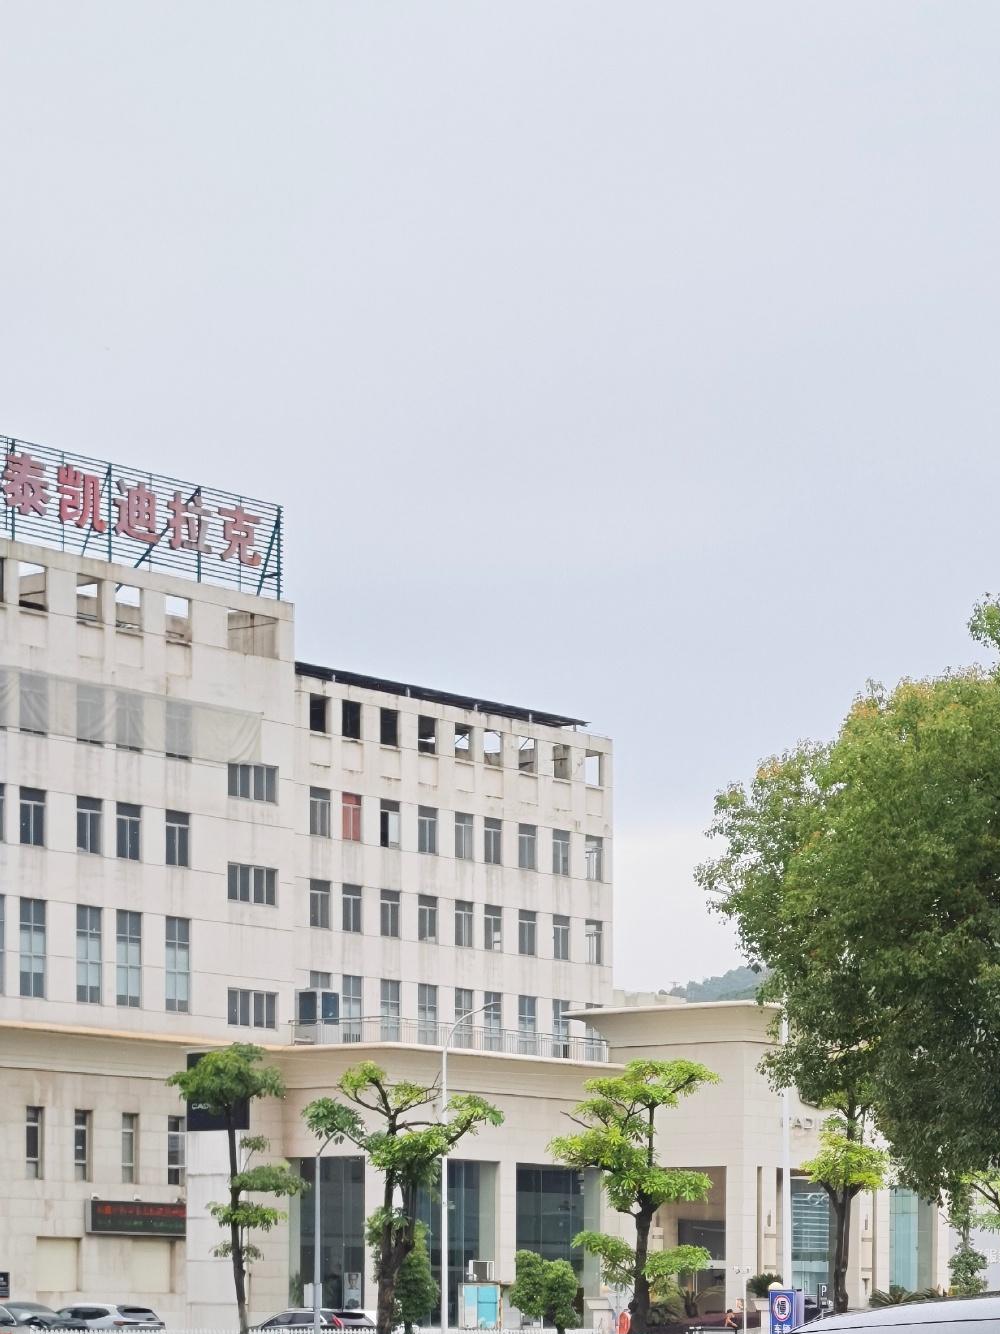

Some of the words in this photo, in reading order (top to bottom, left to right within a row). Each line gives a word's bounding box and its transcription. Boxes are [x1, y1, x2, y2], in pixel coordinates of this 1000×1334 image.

[3, 452, 262, 567] 泰凯迪拉克
[821, 1285, 827, 1296] P
